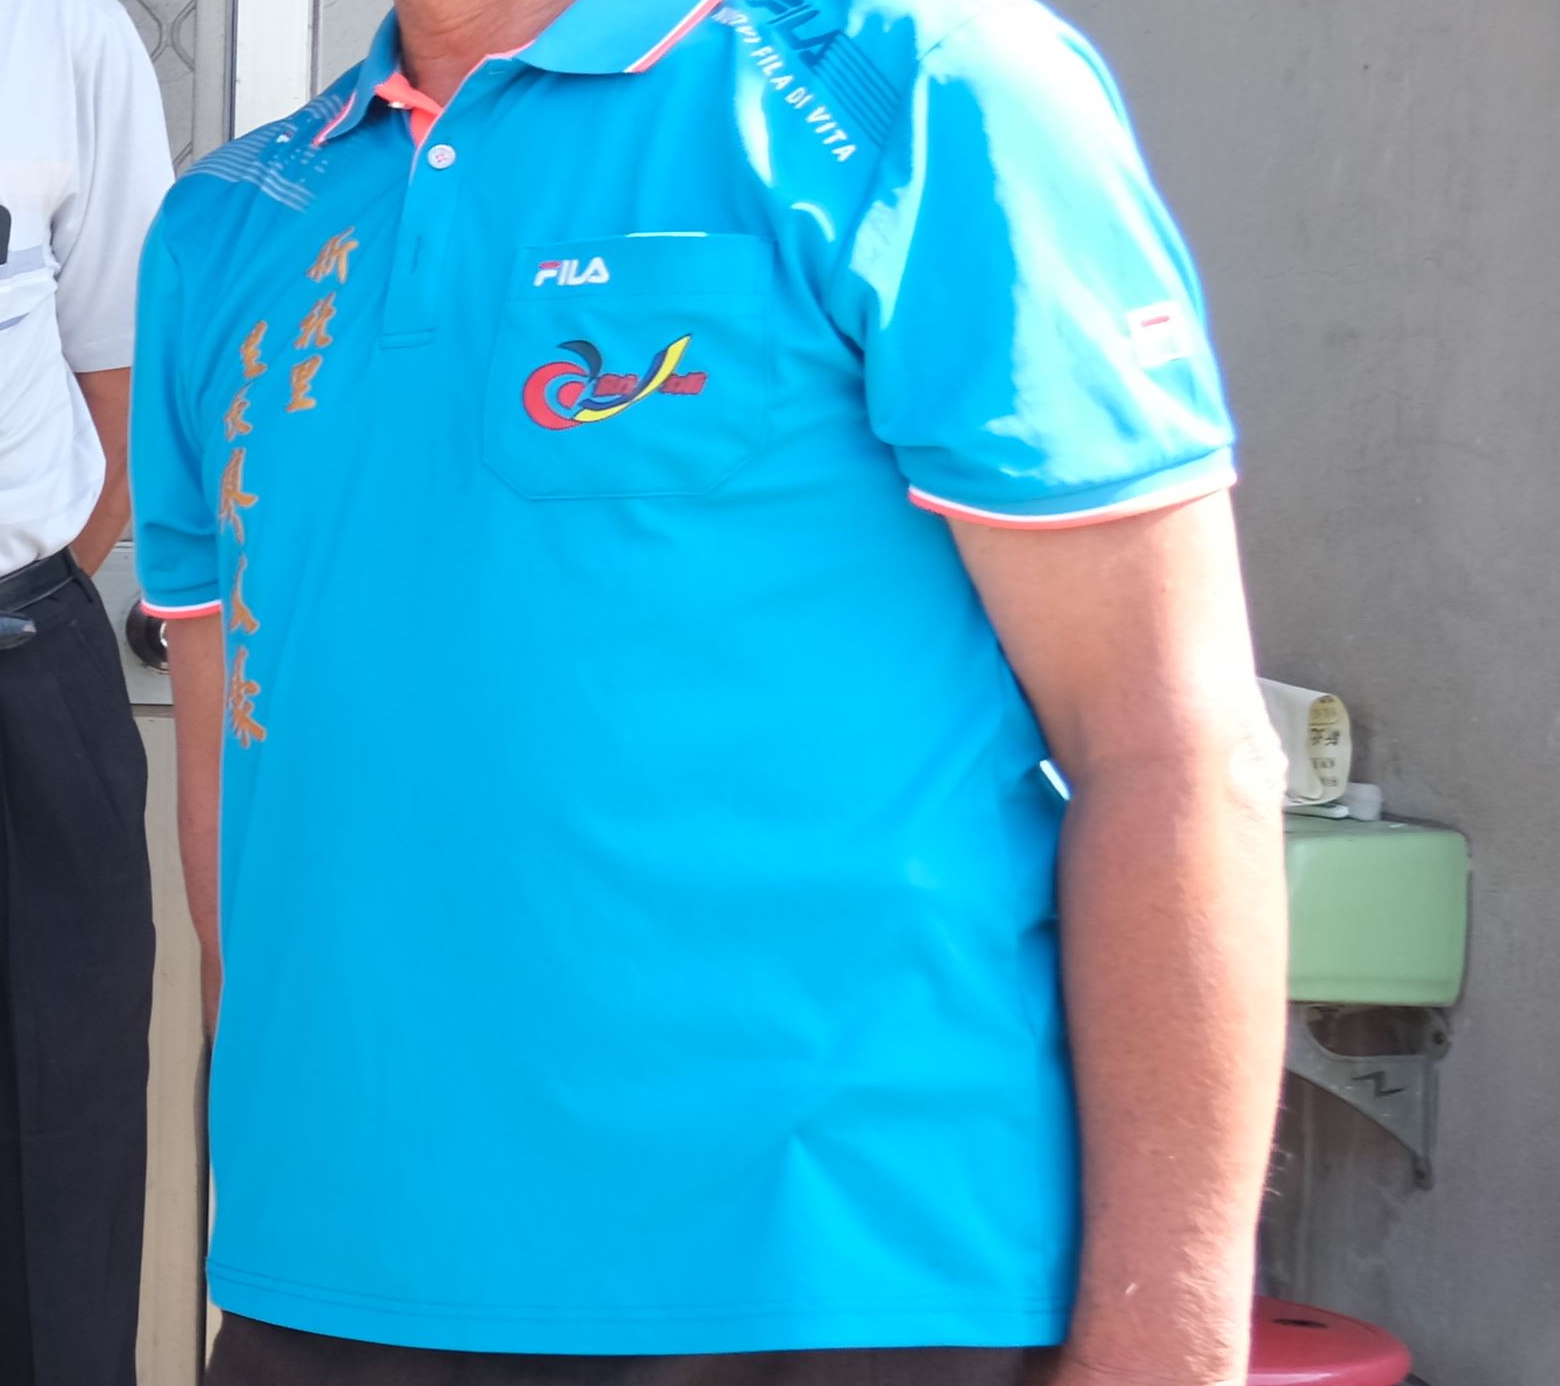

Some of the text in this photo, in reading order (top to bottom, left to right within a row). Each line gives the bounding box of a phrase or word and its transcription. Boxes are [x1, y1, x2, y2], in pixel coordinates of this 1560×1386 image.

[749, 45, 794, 91] FILA
[784, 86, 814, 110] DI
[806, 105, 857, 162] VITA
[533, 256, 611, 288] FILA
